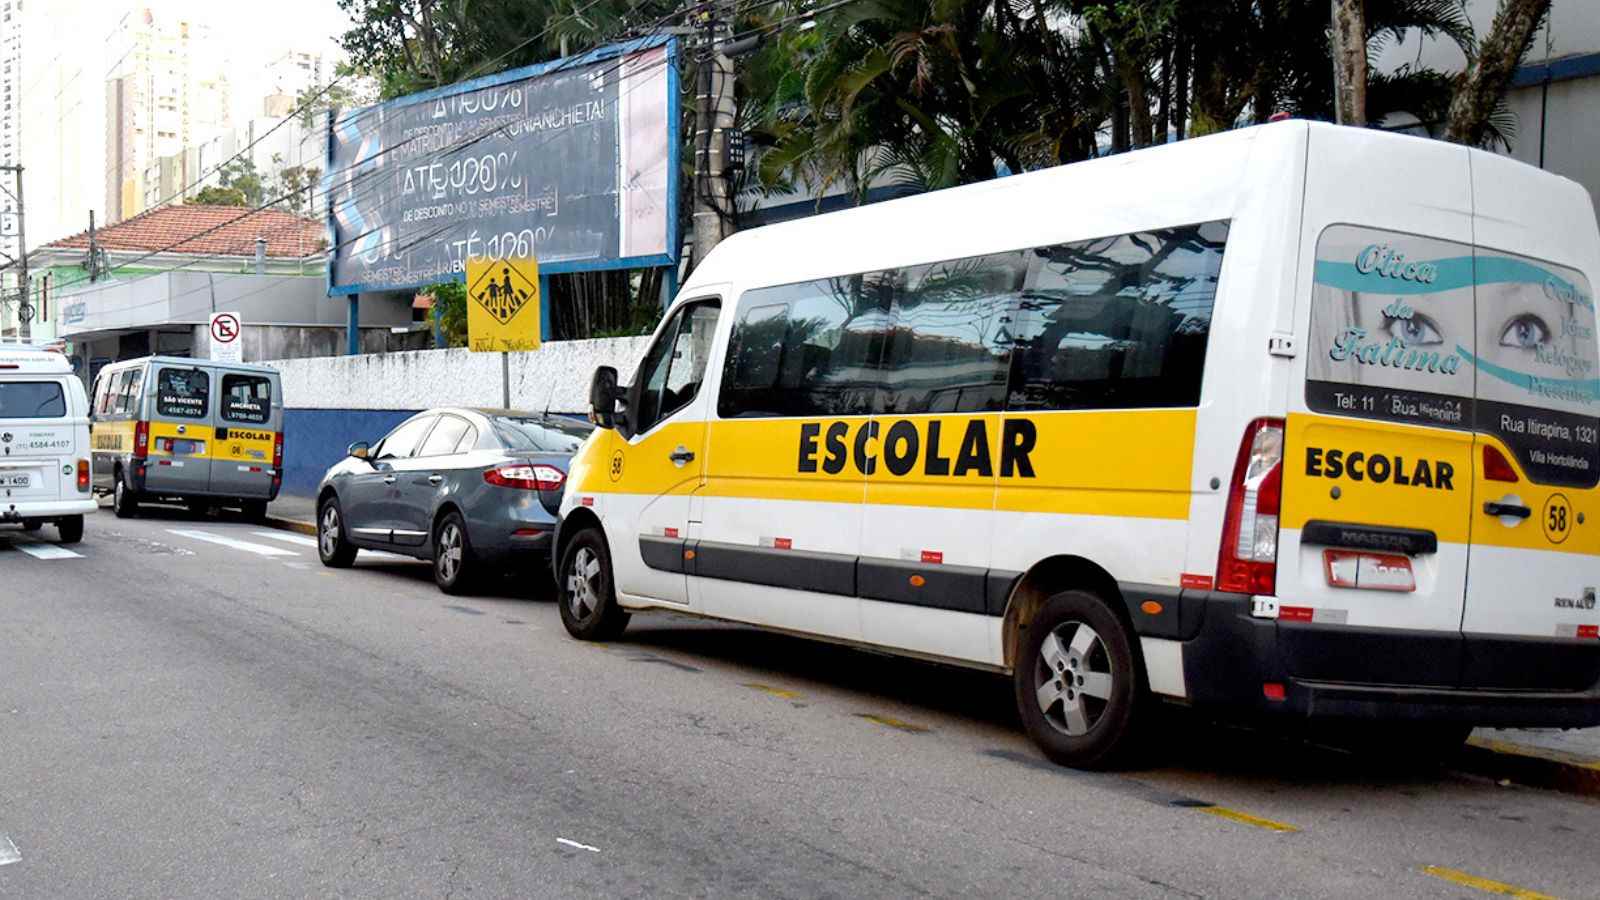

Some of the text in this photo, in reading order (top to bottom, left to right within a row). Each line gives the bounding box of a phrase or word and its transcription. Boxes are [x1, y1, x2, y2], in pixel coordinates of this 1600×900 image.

[1381, 298, 1415, 320] da
[178, 397, 203, 406] VICENTE
[1334, 392, 1375, 411] Tel: 11
[229, 430, 271, 441] ESCOLAR
[1500, 414, 1598, 444] Rua Itirapina, 1321
[798, 418, 1038, 479] ESCOLAR
[1529, 449, 1546, 465] Vila
[611, 456, 622, 475] 58
[1305, 446, 1455, 491] ESCOLAR
[1548, 505, 1566, 532] 58
